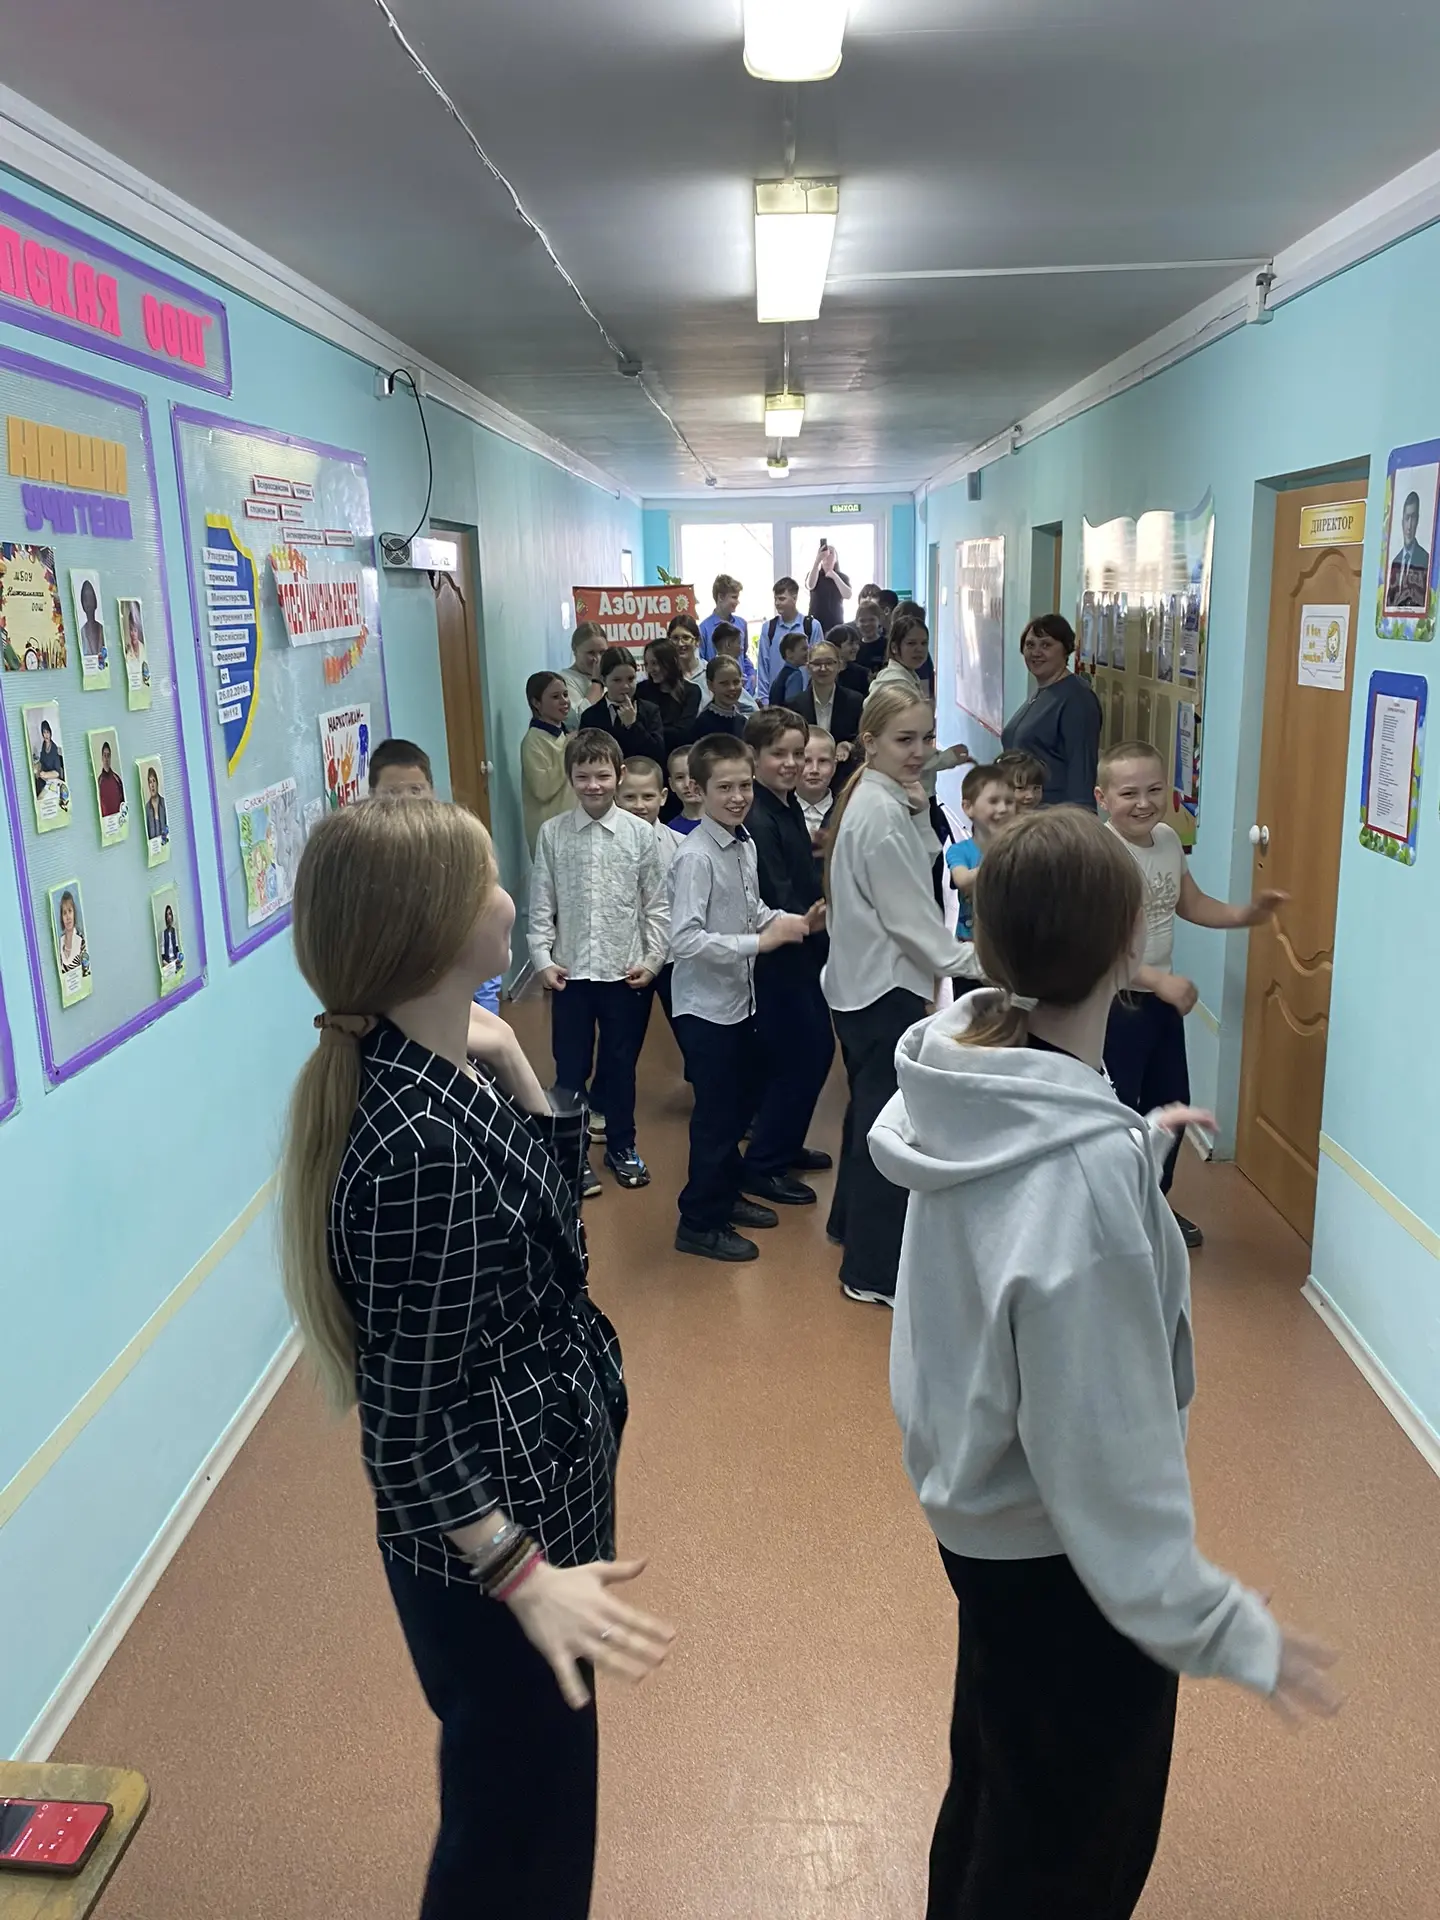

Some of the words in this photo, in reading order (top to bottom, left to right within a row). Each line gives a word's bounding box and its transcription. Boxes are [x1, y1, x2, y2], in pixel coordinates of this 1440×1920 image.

[7, 415, 127, 496] НАШИ
[832, 504, 859, 513] ВЫХОД
[1310, 515, 1354, 535] ДИРЕКТОР
[209, 574, 235, 583] приказом
[211, 592, 248, 603] Министерства
[599, 591, 671, 620] Азбука
[215, 631, 246, 642] Российской
[217, 651, 245, 662] Федерации
[221, 672, 228, 681] от
